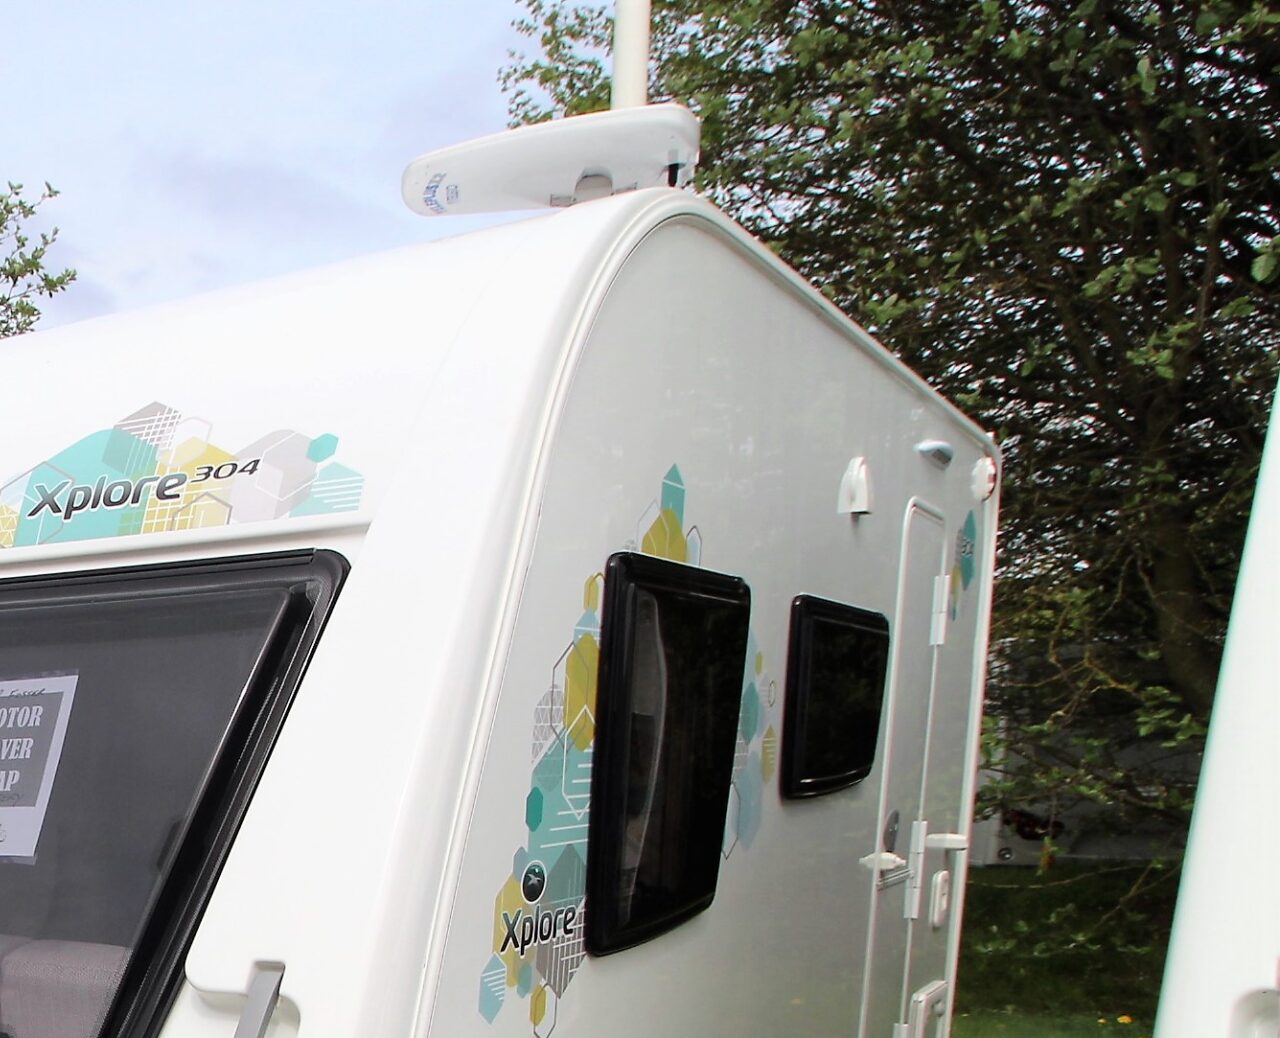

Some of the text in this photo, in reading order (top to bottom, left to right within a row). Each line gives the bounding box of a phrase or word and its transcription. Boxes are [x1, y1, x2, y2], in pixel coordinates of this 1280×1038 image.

[27, 458, 261, 520] Xplore 304
[500, 905, 576, 957] Xplore
